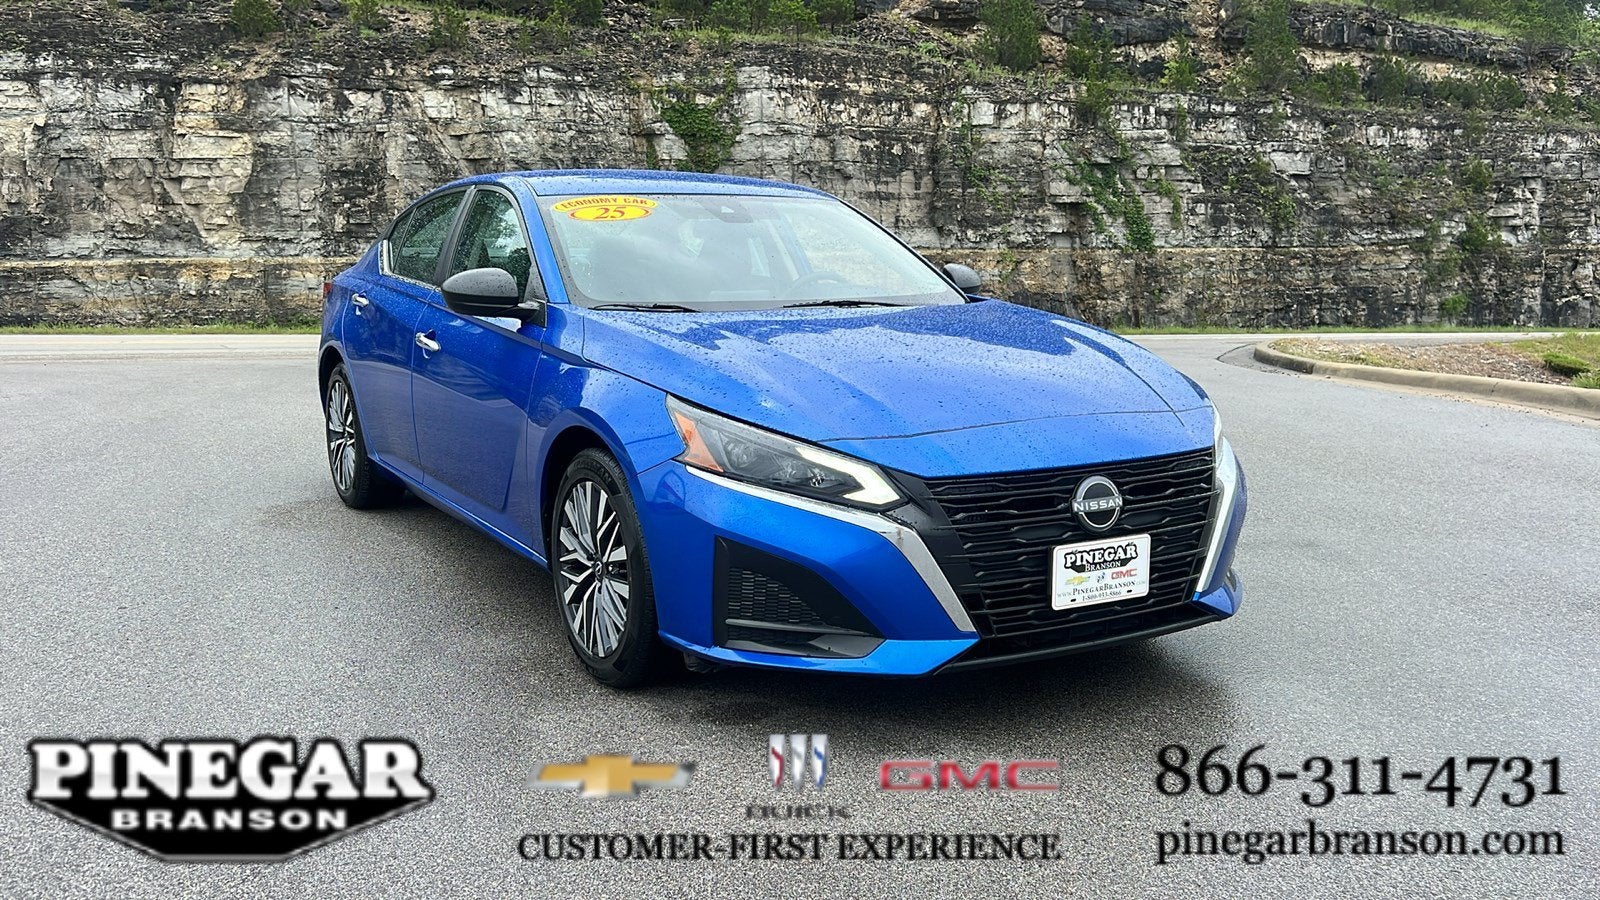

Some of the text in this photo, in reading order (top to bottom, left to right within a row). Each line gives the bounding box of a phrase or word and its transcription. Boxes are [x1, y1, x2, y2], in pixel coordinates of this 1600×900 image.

[560, 197, 648, 209] ECONOMY CAR
[593, 205, 627, 219] 25
[1073, 497, 1123, 512] NISSAN
[1064, 545, 1138, 569] PINEGAR
[1085, 560, 1121, 572] BRANSON
[1111, 568, 1137, 580] GMC
